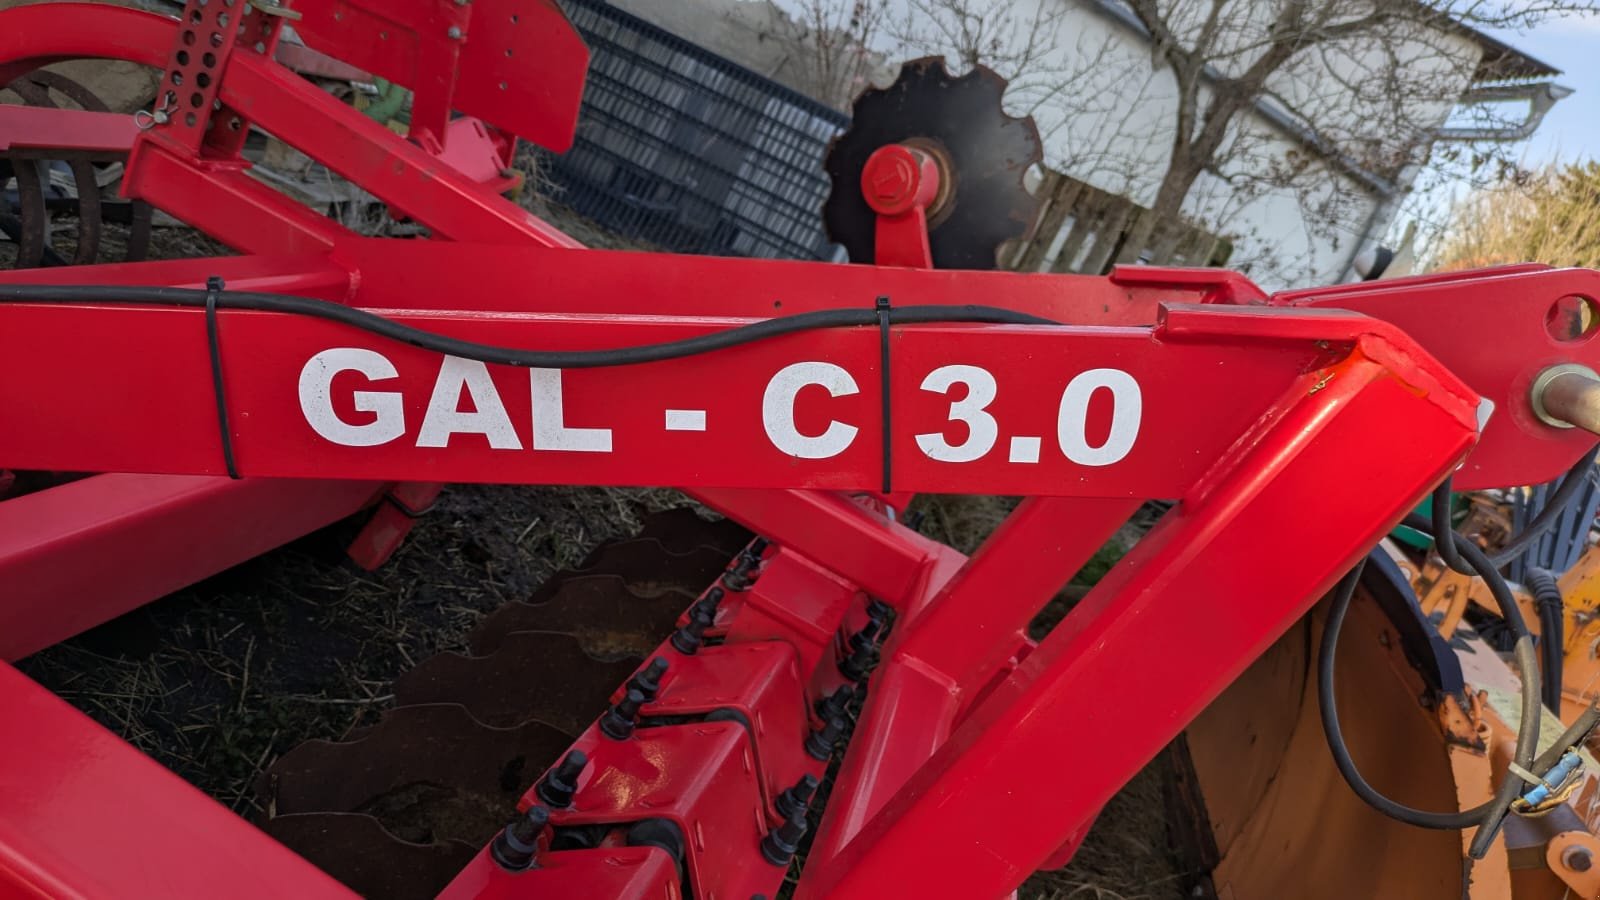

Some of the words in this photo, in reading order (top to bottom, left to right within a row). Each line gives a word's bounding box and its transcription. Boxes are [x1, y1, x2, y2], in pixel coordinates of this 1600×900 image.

[298, 347, 613, 450] GAL
[762, 361, 859, 459] C
[914, 364, 1142, 467] 3.0
